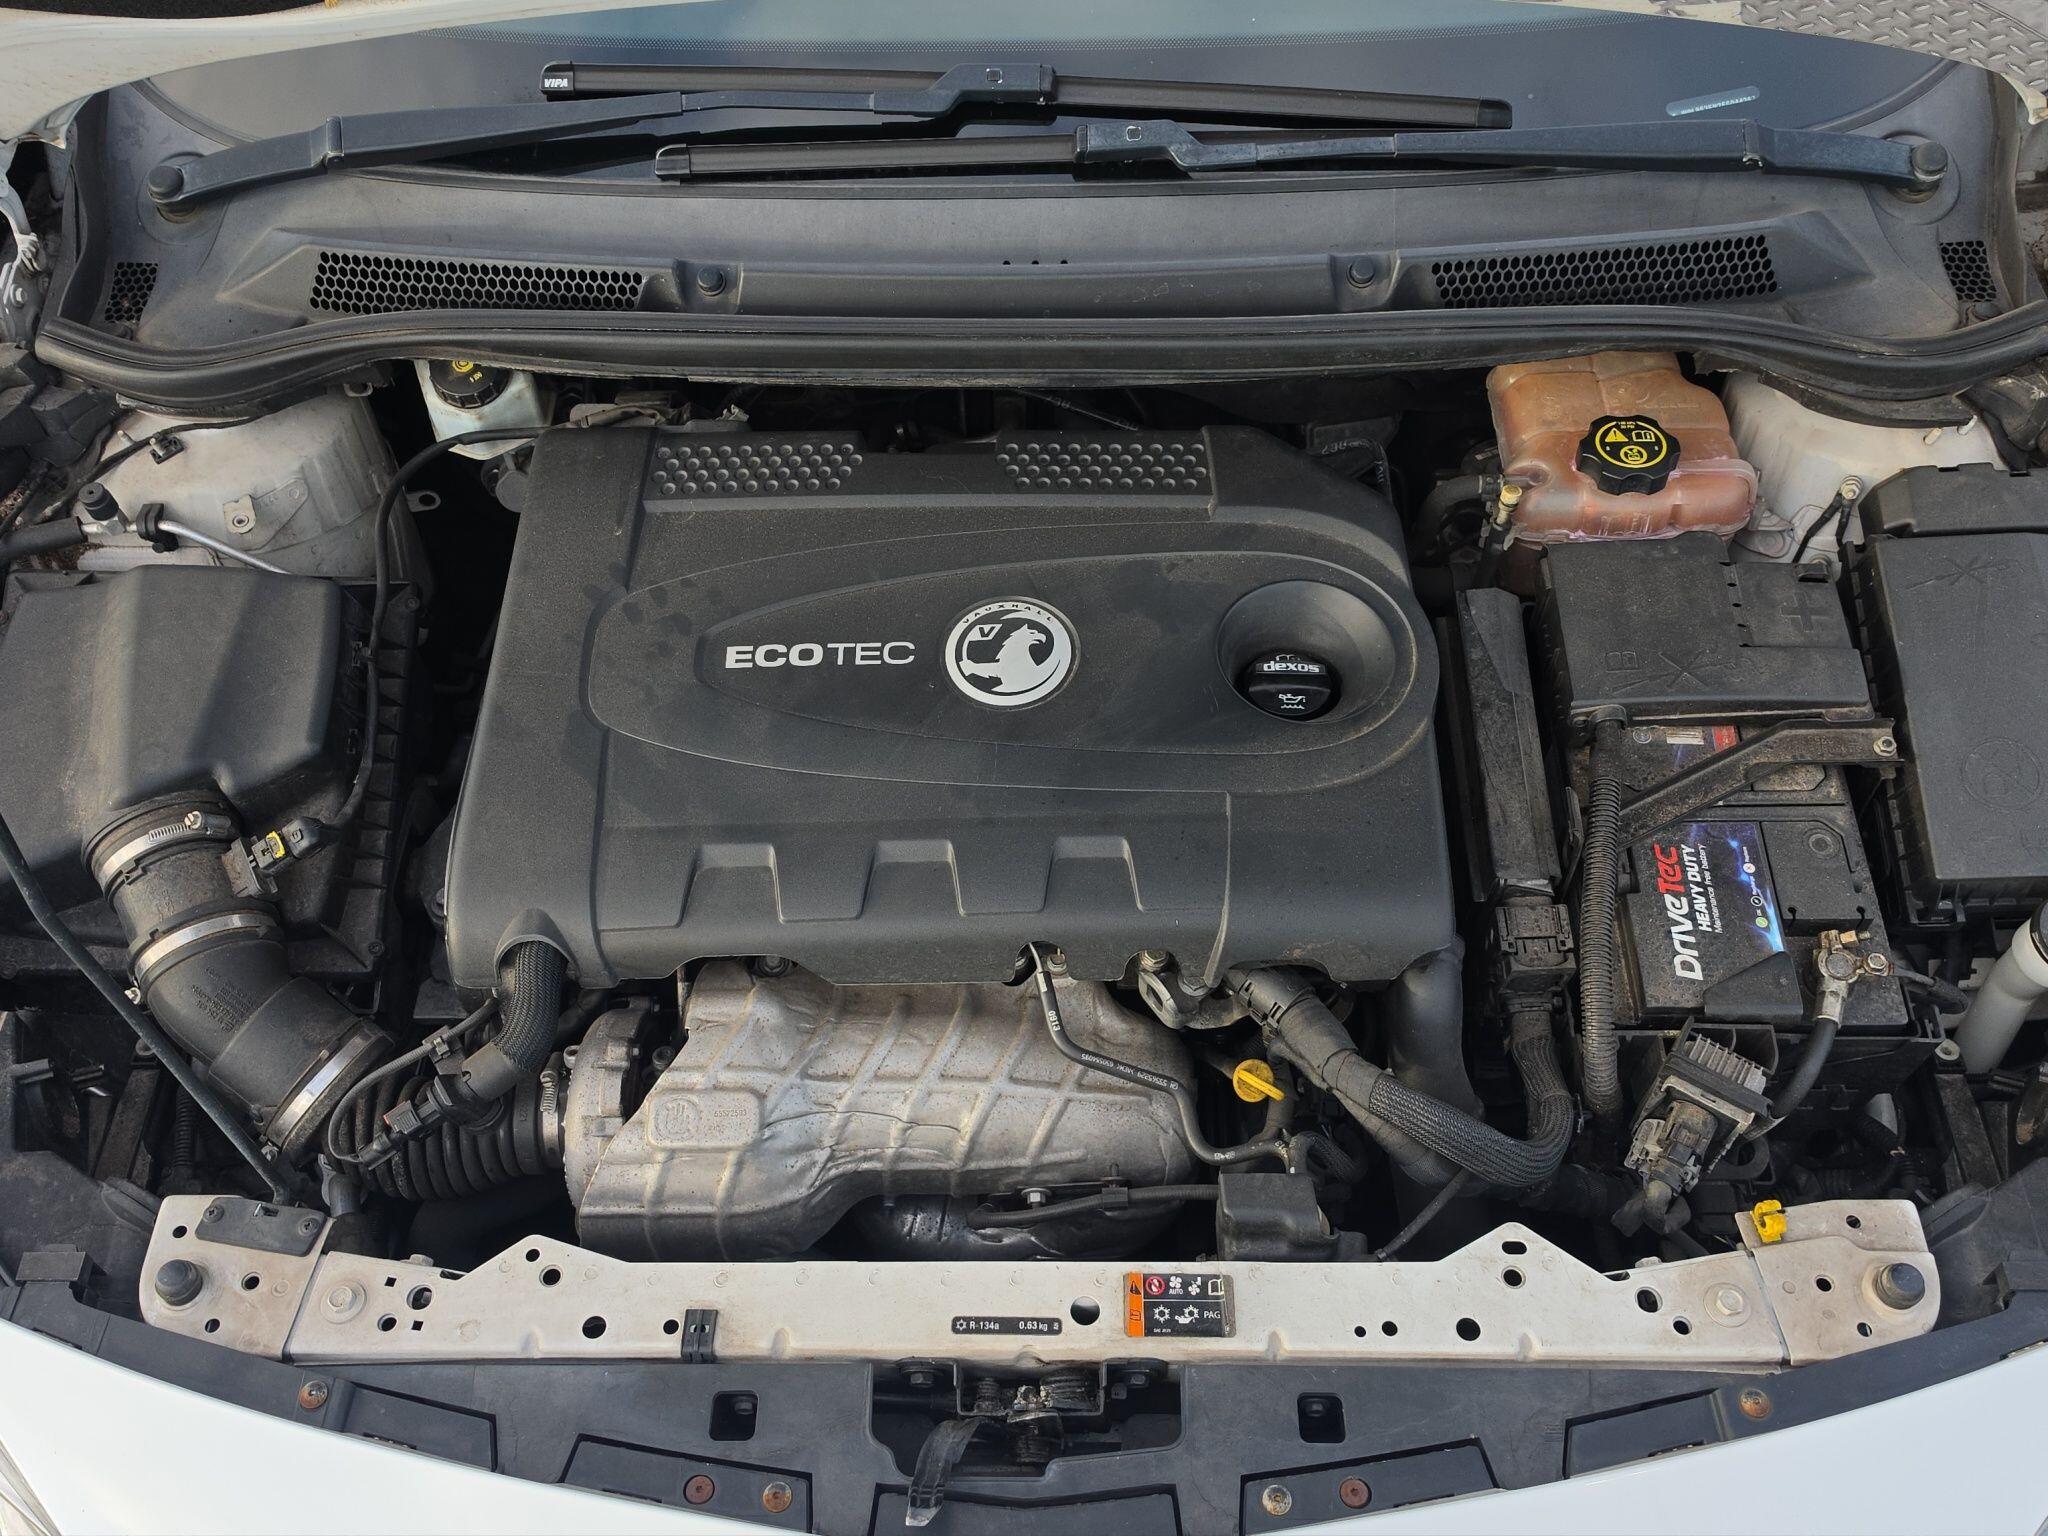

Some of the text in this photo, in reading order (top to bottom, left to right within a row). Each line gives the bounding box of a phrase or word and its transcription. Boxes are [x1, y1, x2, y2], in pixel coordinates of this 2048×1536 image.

[544, 78, 568, 88] VIPA
[962, 603, 1053, 624] VAUXHALL
[725, 641, 916, 669] ECOTEC
[1263, 660, 1320, 673] dexos
[1681, 843, 1713, 932] HEAVY DUTY
[1698, 843, 1723, 934] Maintenance free battery
[1048, 1010, 1061, 1031] 0913
[1203, 1310, 1221, 1319] PAG
[969, 1321, 1000, 1330] R-134a
[1018, 1320, 1037, 1330] 0.63
[1038, 1321, 1048, 1332] kg
